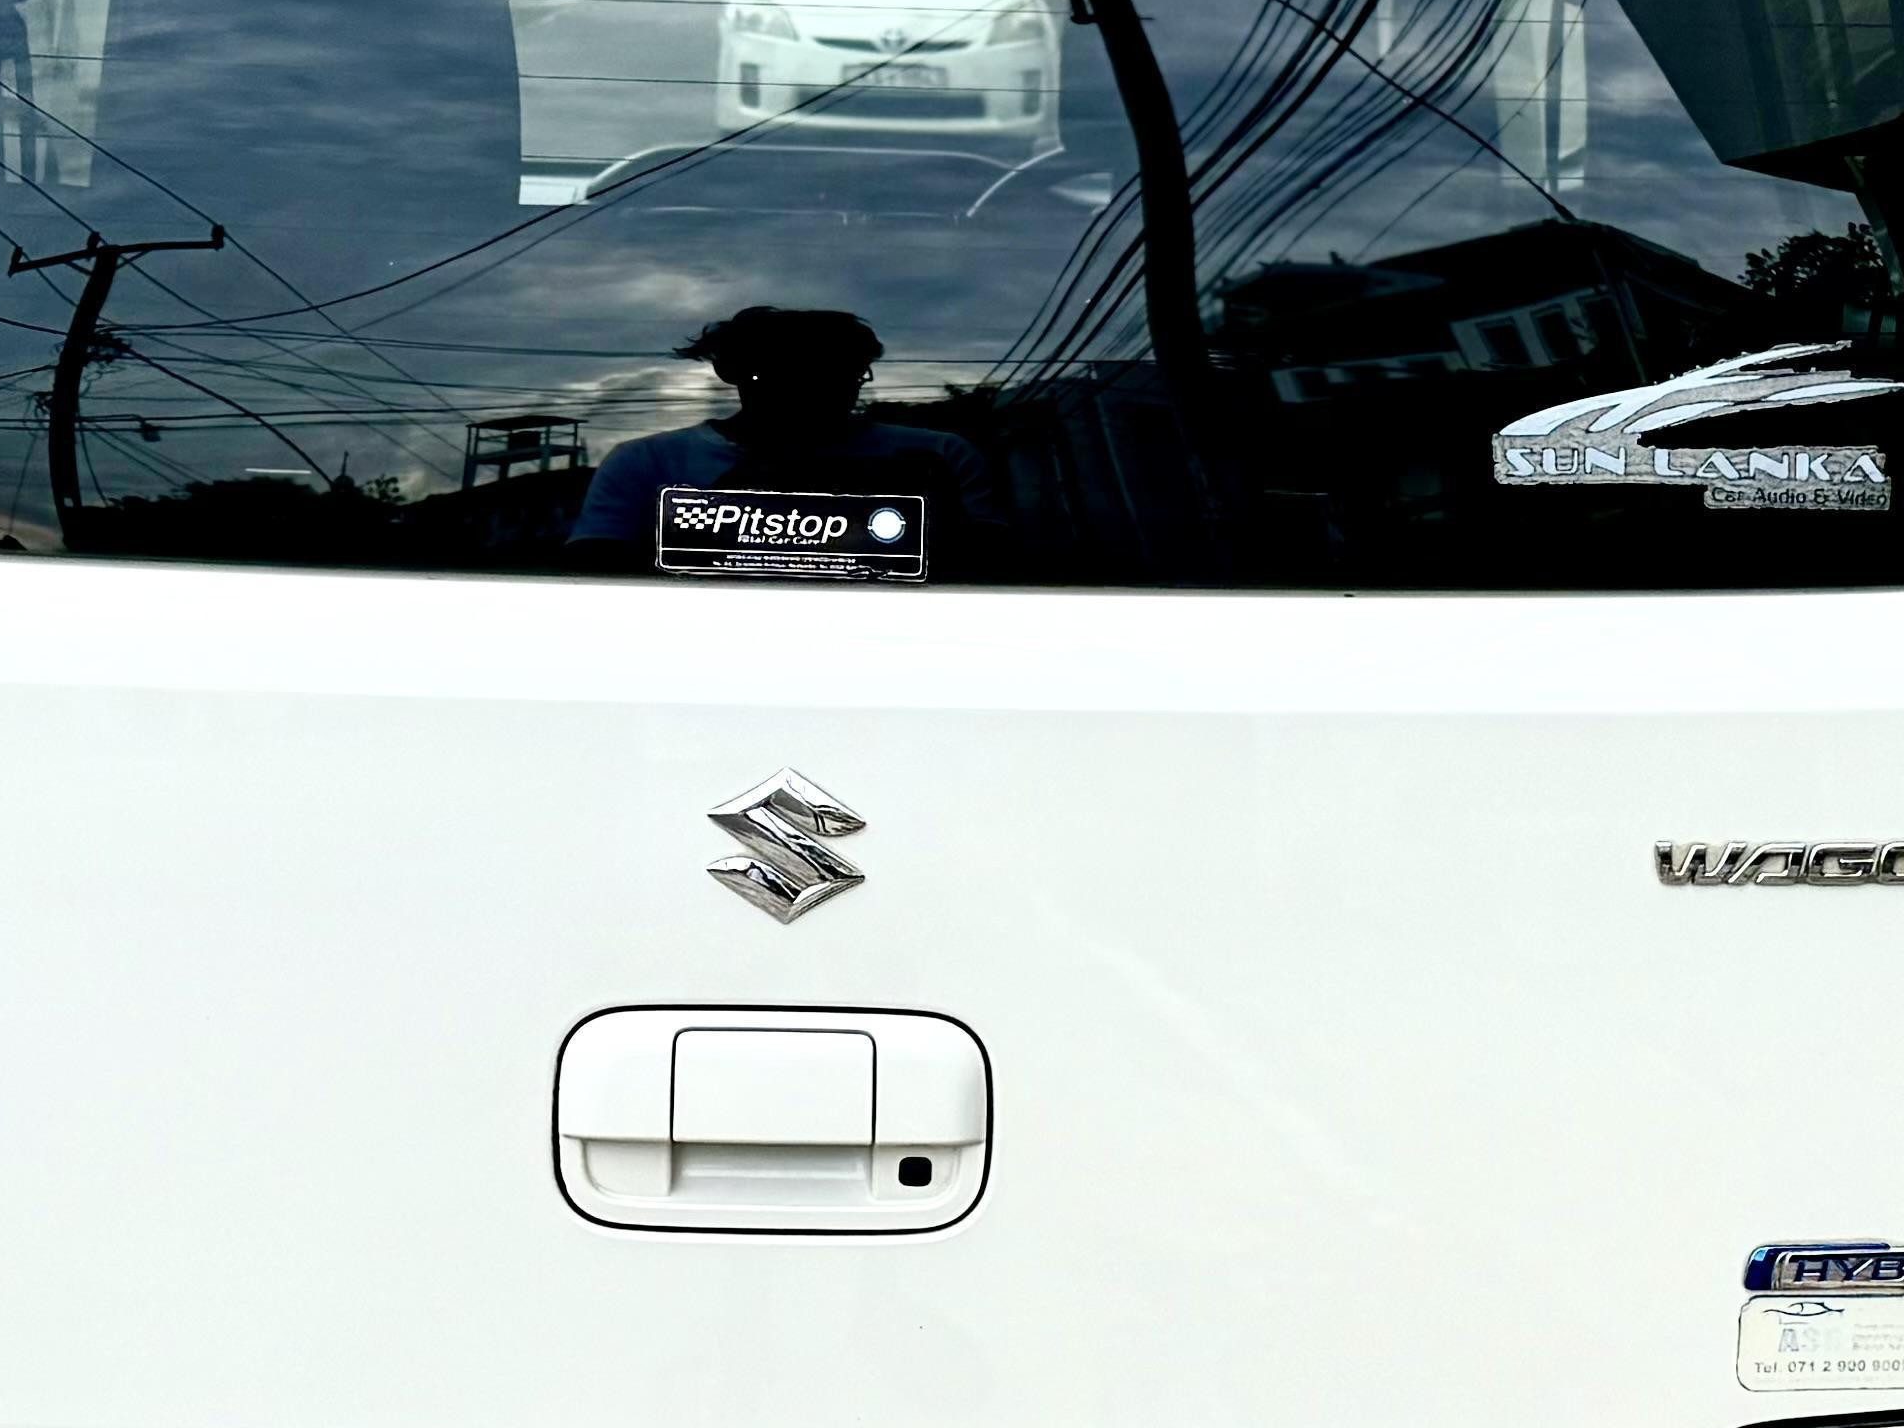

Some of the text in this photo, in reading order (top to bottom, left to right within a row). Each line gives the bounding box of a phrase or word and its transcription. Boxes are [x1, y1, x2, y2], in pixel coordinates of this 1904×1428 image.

[1503, 446, 1887, 483] SUN LANKA
[1753, 488, 1807, 504] Audio
[1813, 488, 1830, 504] &
[1837, 489, 1887, 506] Video
[712, 505, 849, 544] Pitstop
[1787, 1360, 1815, 1373] 071
[1822, 1360, 1832, 1372] 2
